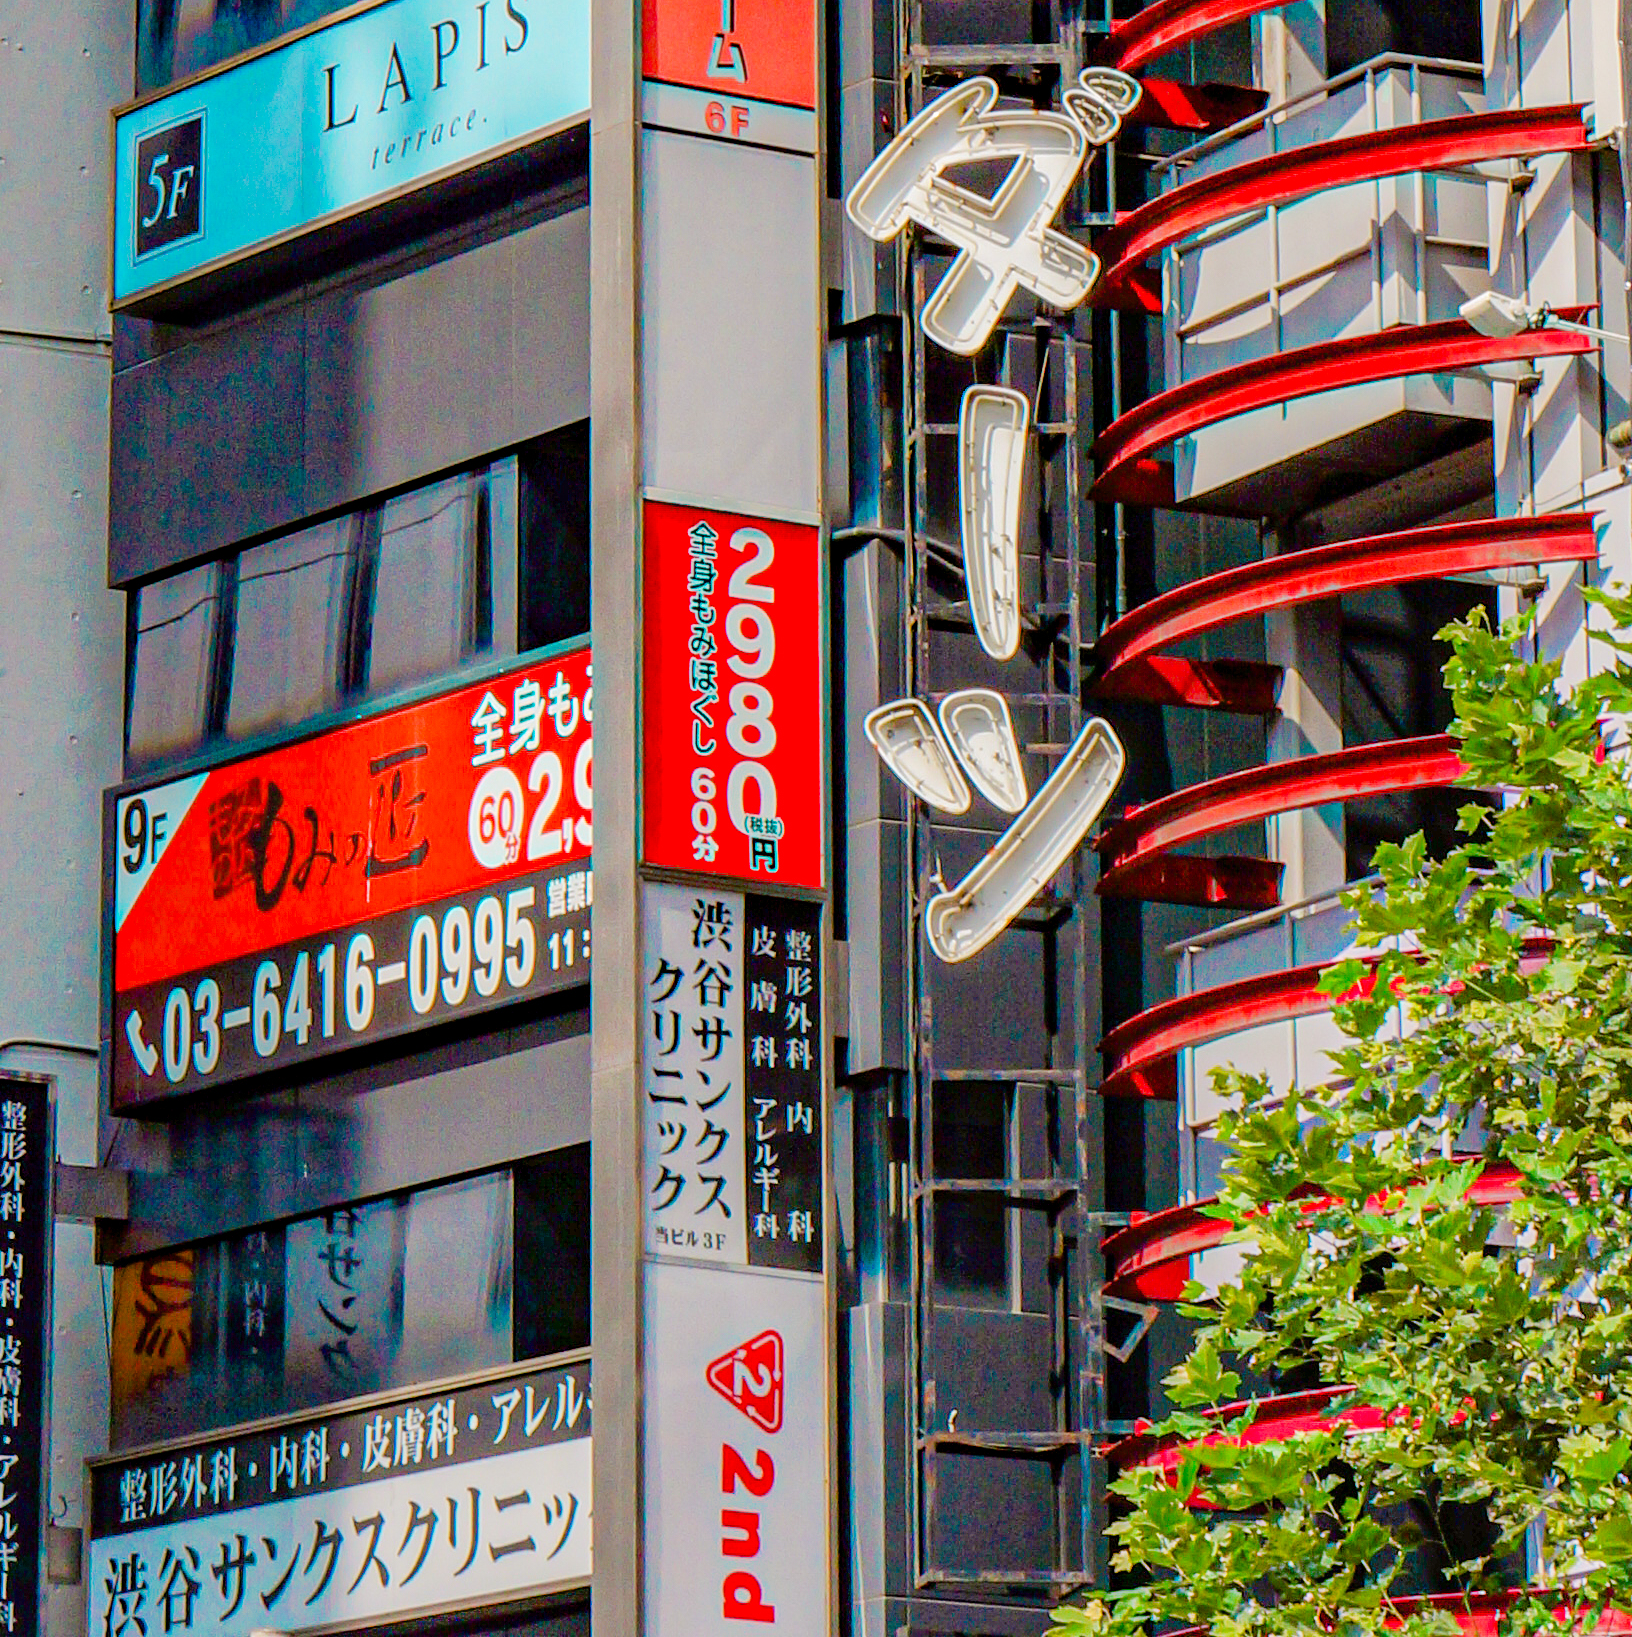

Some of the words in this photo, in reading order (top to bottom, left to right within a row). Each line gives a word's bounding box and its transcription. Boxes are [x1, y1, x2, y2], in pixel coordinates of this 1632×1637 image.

[142, 152, 196, 229] 5F
[703, 101, 750, 140] 6F
[687, 522, 718, 756] 全身もみほぐし
[123, 797, 168, 875] 9F
[690, 767, 719, 863] 60分
[547, 870, 593, 919] 営業
[161, 885, 537, 1084] 03-6416-0995
[749, 926, 780, 1070] 皮膚科
[783, 928, 814, 1072] 整形外科
[649, 957, 689, 1214] クリニック
[690, 897, 733, 1219] 渋谷サンクス
[752, 1096, 781, 1241] アレルギー科
[119, 1375, 593, 1524] 整形外科・内科・皮膚科・アレル
[103, 1486, 593, 1637] 渋谷サンクスクリニッ
[721, 1442, 777, 1624] 2nd
